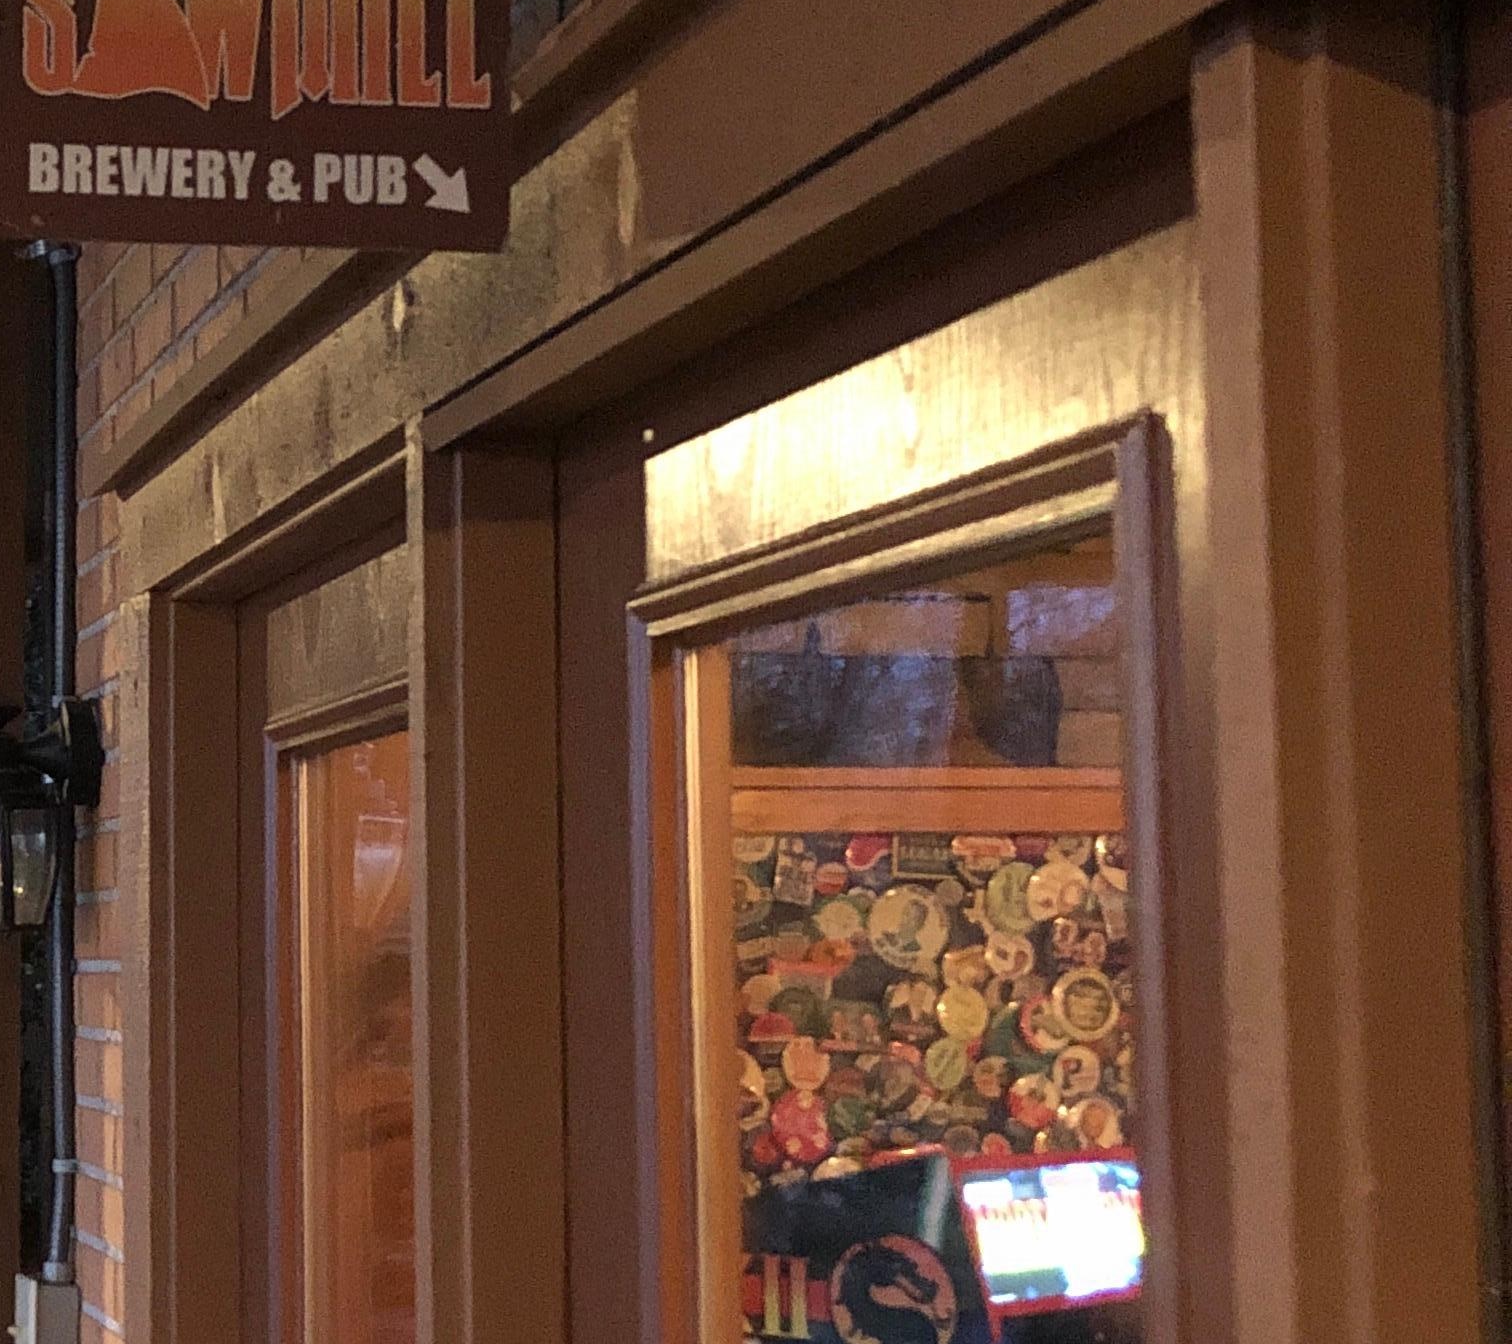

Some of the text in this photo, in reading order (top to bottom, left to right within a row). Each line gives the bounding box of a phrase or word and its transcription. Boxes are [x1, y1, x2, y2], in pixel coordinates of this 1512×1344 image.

[28, 142, 408, 205] BREWERY & PUB
